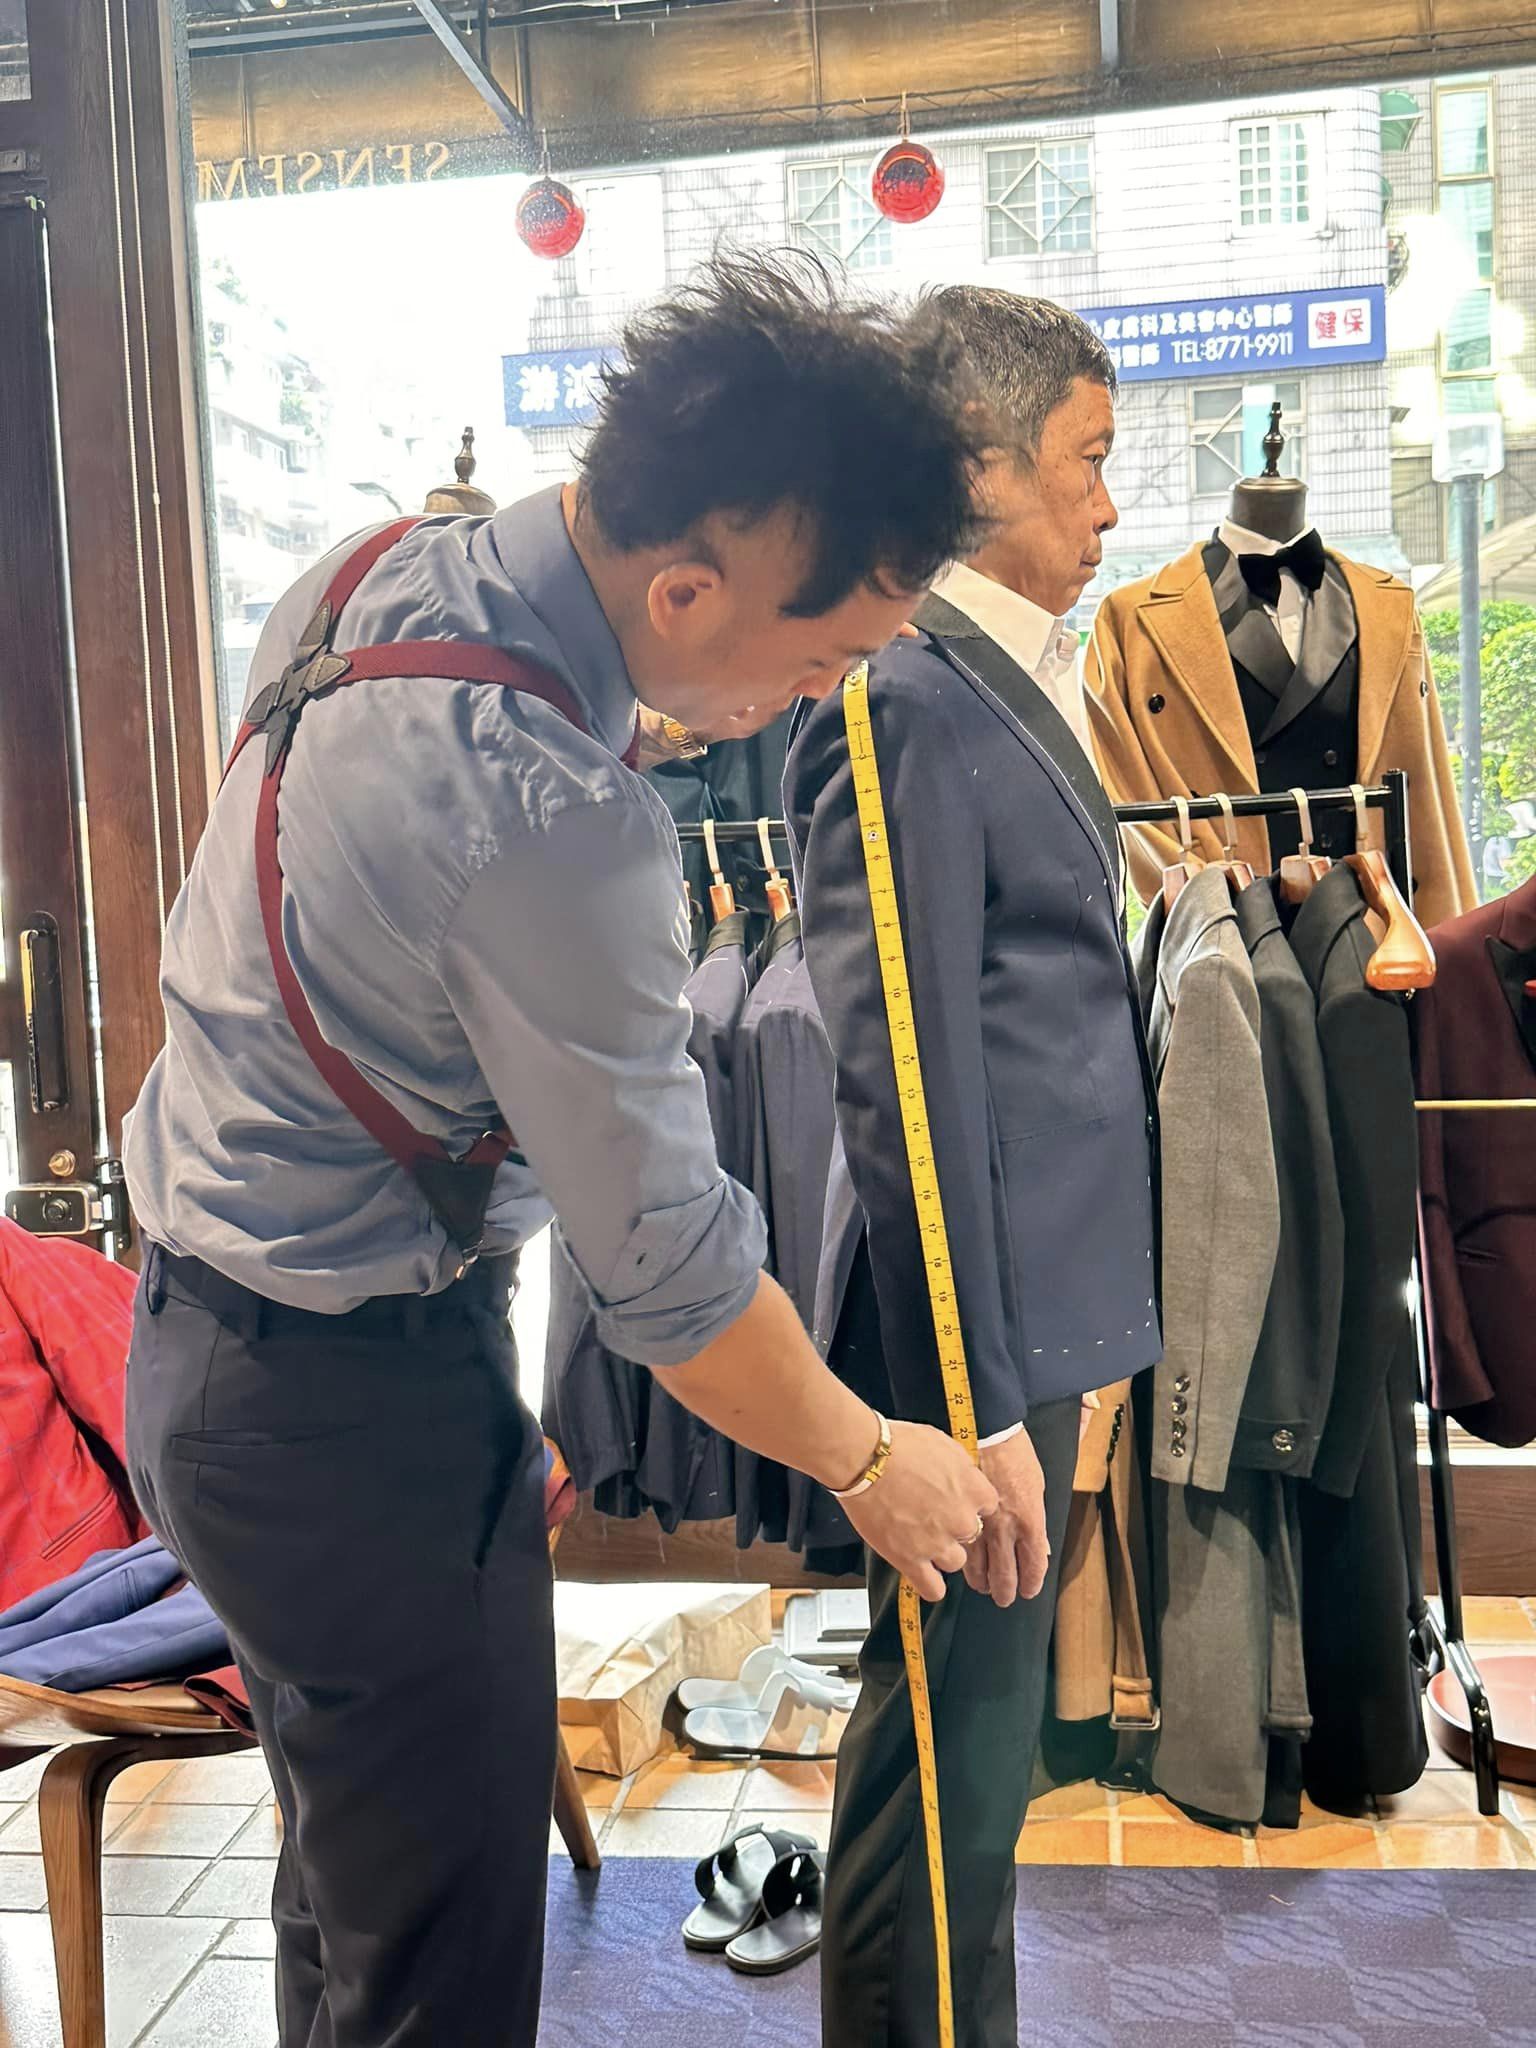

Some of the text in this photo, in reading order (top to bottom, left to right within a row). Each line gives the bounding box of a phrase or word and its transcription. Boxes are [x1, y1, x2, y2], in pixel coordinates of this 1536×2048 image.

[1315, 307, 1364, 340] 健保
[1171, 331, 1293, 364] TEL:8771-9911
[893, 987, 901, 998] 10
[898, 1020, 906, 1031] 11
[902, 1054, 911, 1065] 12
[907, 1088, 915, 1099] 13
[912, 1122, 921, 1133] 14
[917, 1155, 926, 1167] 15
[922, 1189, 931, 1201] 16
[928, 1222, 937, 1235] 17
[933, 1257, 942, 1268] 18
[939, 1291, 948, 1303] 19
[943, 1323, 953, 1336] 20
[948, 1359, 958, 1371] 21
[954, 1392, 964, 1405] 22
[959, 1427, 969, 1440] 23
